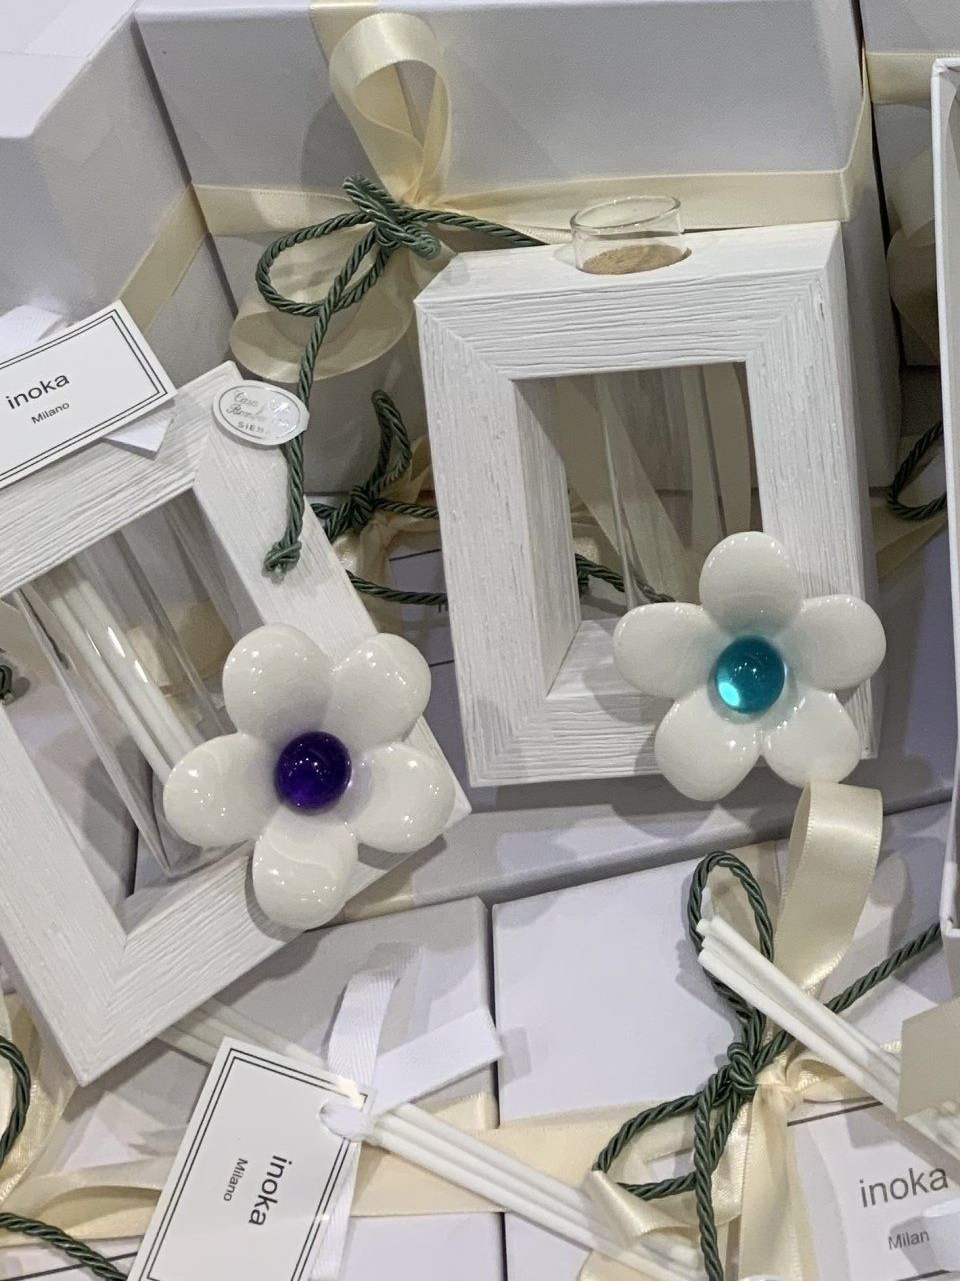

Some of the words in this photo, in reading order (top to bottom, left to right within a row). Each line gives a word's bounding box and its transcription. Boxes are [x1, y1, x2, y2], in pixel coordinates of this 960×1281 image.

[5, 374, 70, 410] inoka
[31, 402, 70, 424] Milano
[223, 1158, 248, 1202] Milano
[248, 1155, 292, 1226] inoka
[859, 1167, 949, 1208] inoka
[887, 1230, 931, 1251] Milan
